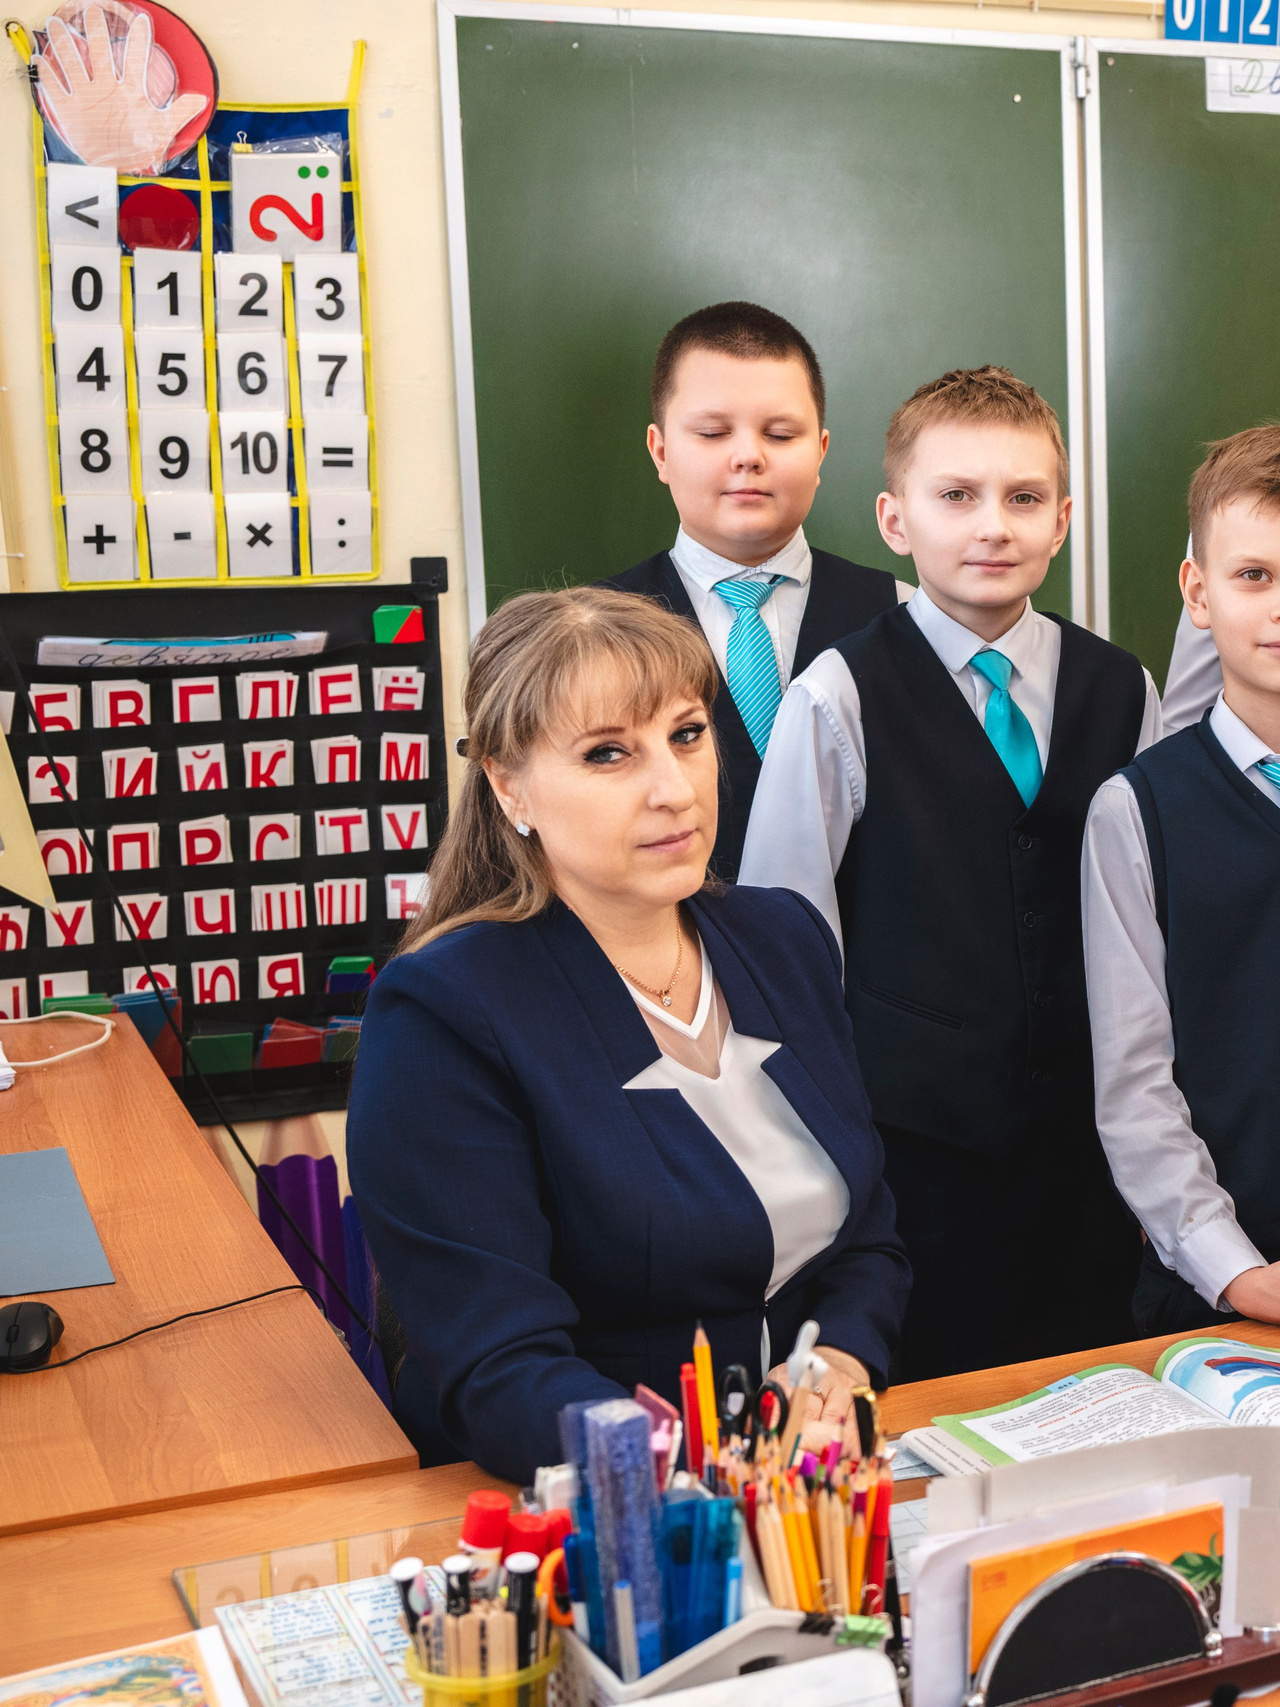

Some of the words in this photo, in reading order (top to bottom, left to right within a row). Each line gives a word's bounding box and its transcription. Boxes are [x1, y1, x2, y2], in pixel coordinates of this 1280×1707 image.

[1172, 0, 1195, 31] 0
[1217, 0, 1229, 33] 1
[1249, 0, 1272, 36] 2
[249, 192, 324, 242] 2
[71, 265, 103, 312] 0
[156, 271, 180, 316] 1
[238, 272, 269, 317] 2
[314, 277, 345, 321] 3
[76, 346, 111, 392] 4
[157, 352, 189, 397] 5
[237, 351, 268, 396] 6
[318, 354, 348, 397] 7
[79, 428, 112, 473] 8
[159, 435, 190, 480] 9
[229, 430, 279, 475] 10
[34, 692, 73, 732] Б
[109, 690, 145, 728] В
[178, 684, 214, 723] Г
[383, 676, 419, 711] Ё
[115, 757, 153, 798] И
[185, 750, 223, 792] Й
[251, 750, 286, 788] К
[385, 741, 421, 781] М
[113, 832, 149, 871] П
[185, 828, 221, 866] Р
[329, 815, 363, 854] Т
[267, 958, 300, 998] Я
